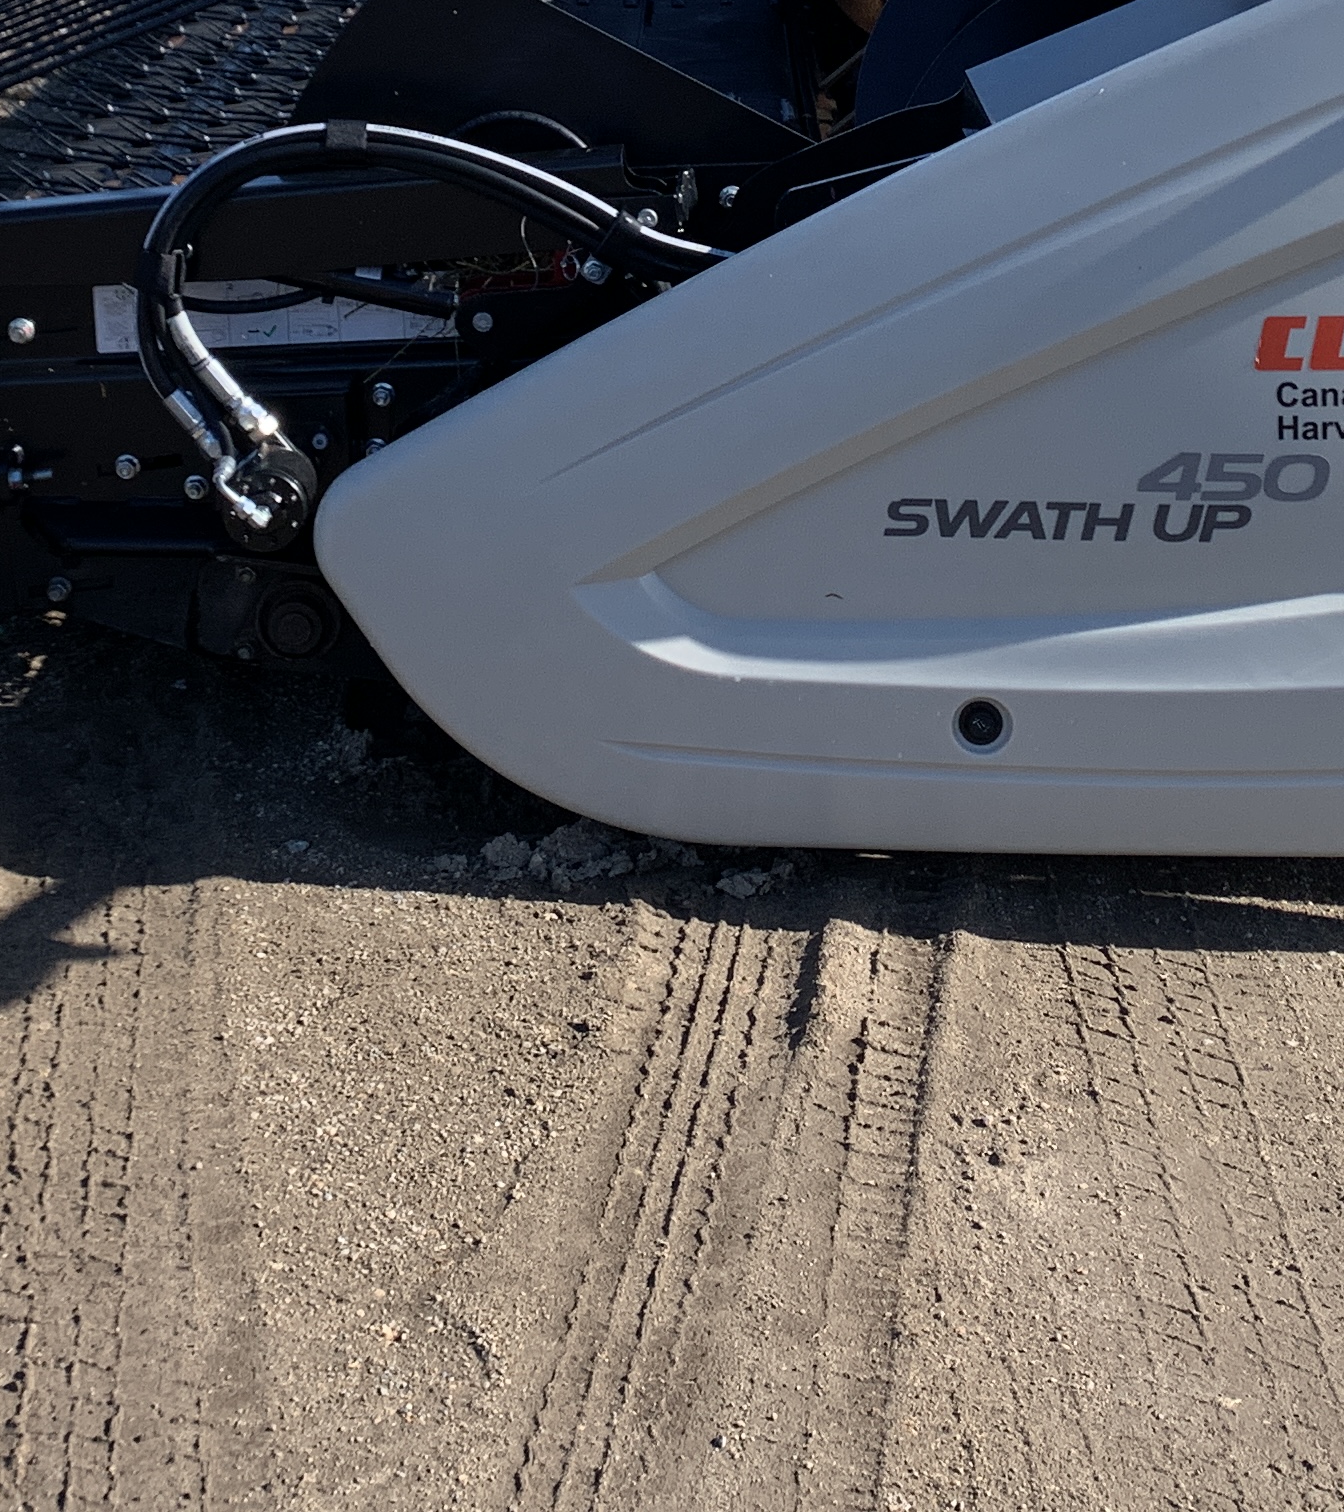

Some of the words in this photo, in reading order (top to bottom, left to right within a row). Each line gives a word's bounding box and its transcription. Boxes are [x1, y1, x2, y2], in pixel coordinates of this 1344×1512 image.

[1137, 452, 1331, 502] 450
[883, 498, 1136, 542] SWATH
[1152, 504, 1253, 543] UP
